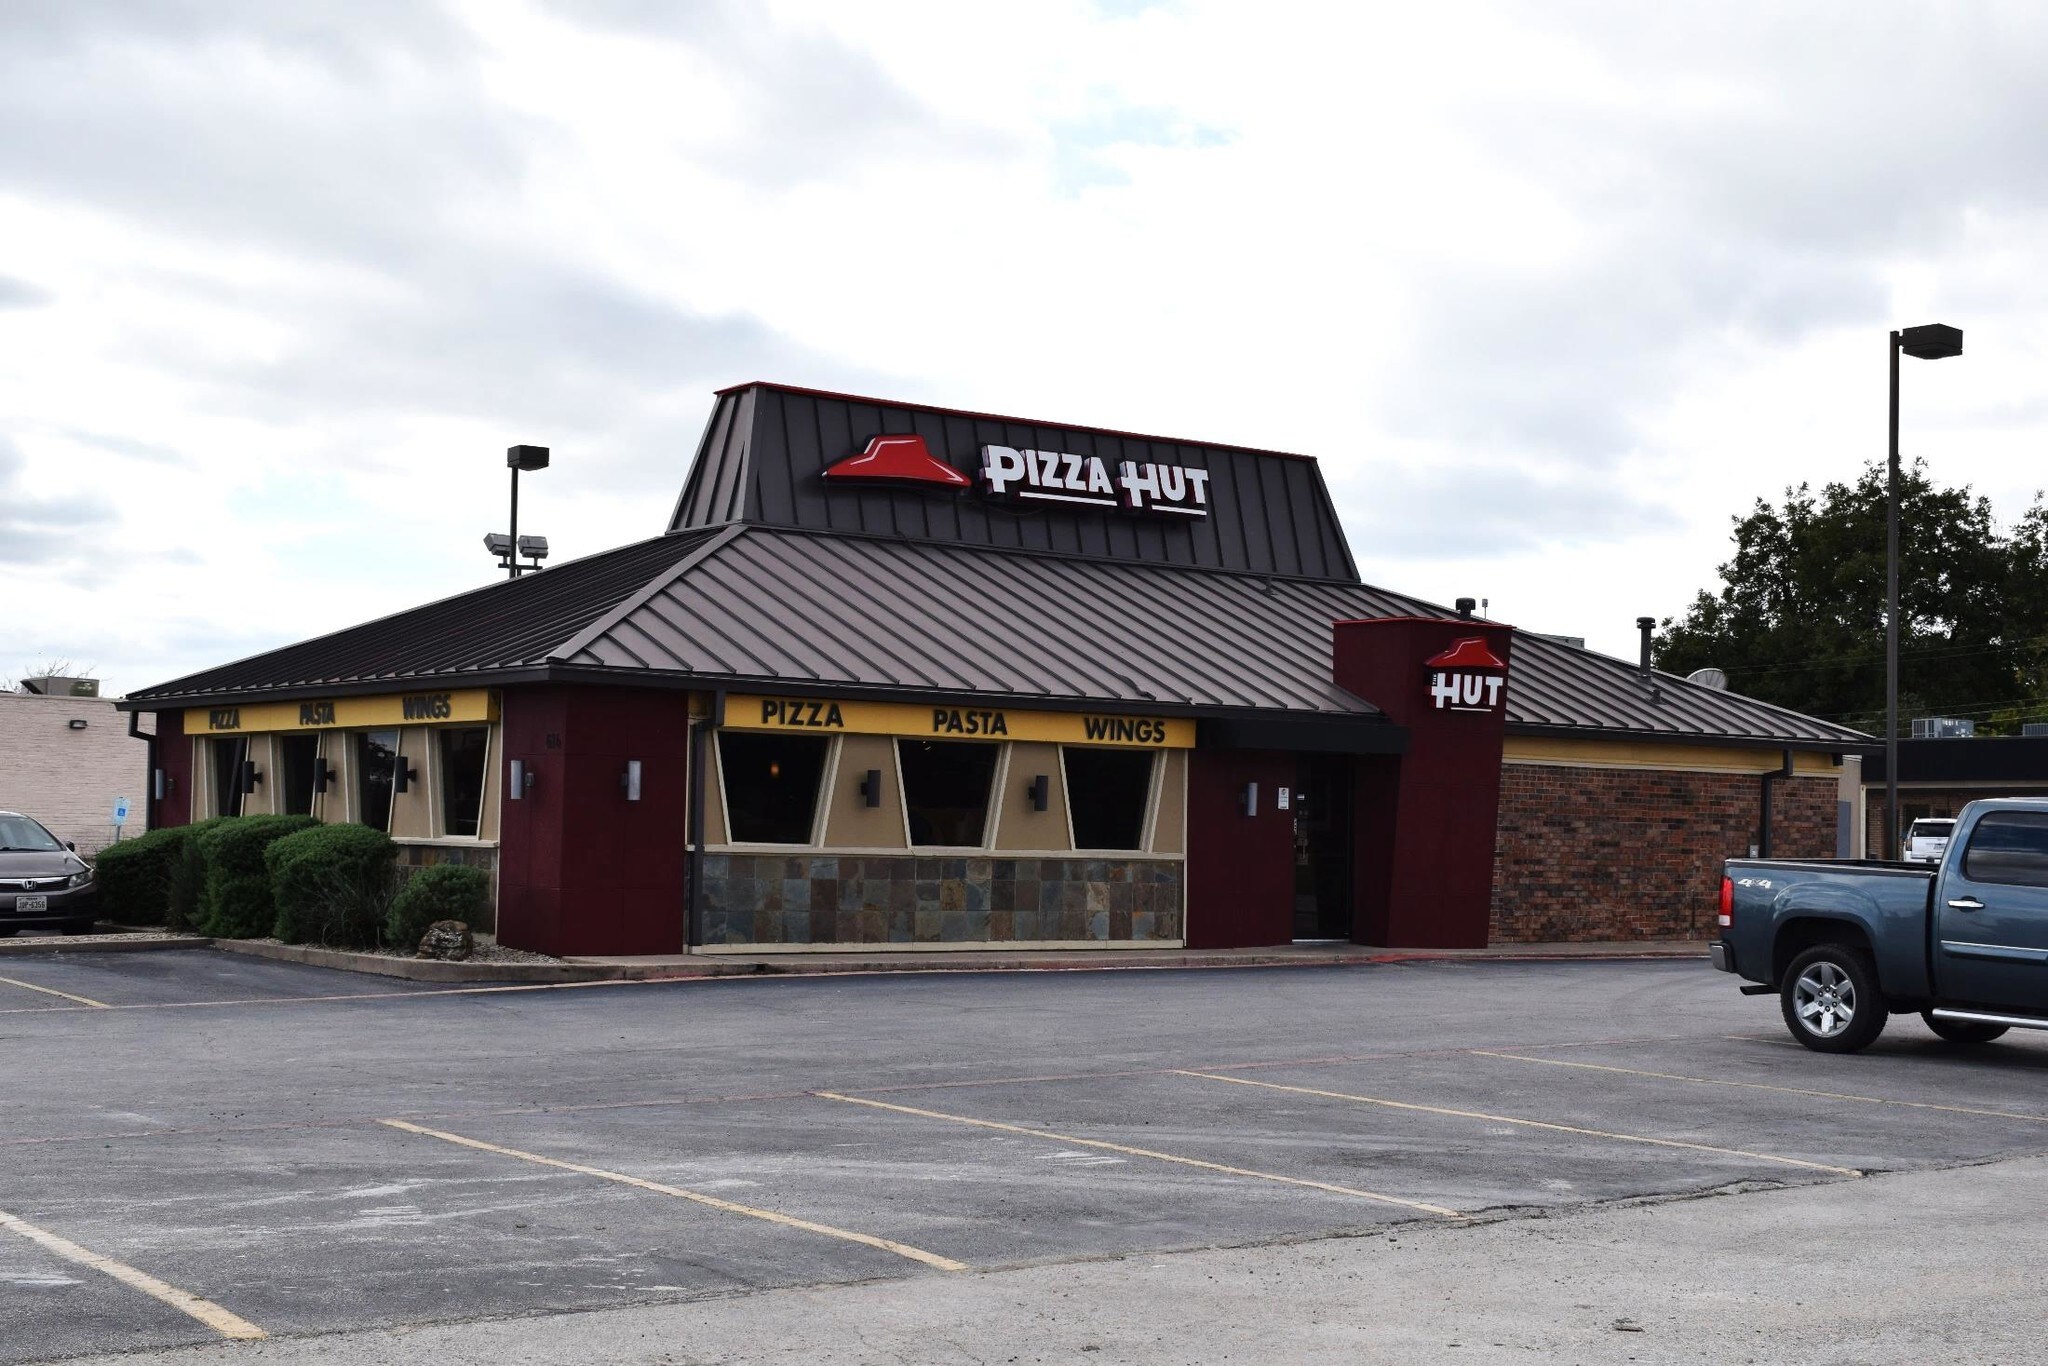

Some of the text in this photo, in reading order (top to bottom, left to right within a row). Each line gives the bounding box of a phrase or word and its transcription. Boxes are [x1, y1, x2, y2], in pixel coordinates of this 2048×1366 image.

[980, 445, 1209, 507] PIZZA HUT
[1431, 673, 1504, 709] HUT
[208, 696, 451, 730] PIZZA PASTA WINGS
[761, 701, 1166, 743] PIZZA PASTA WINGS
